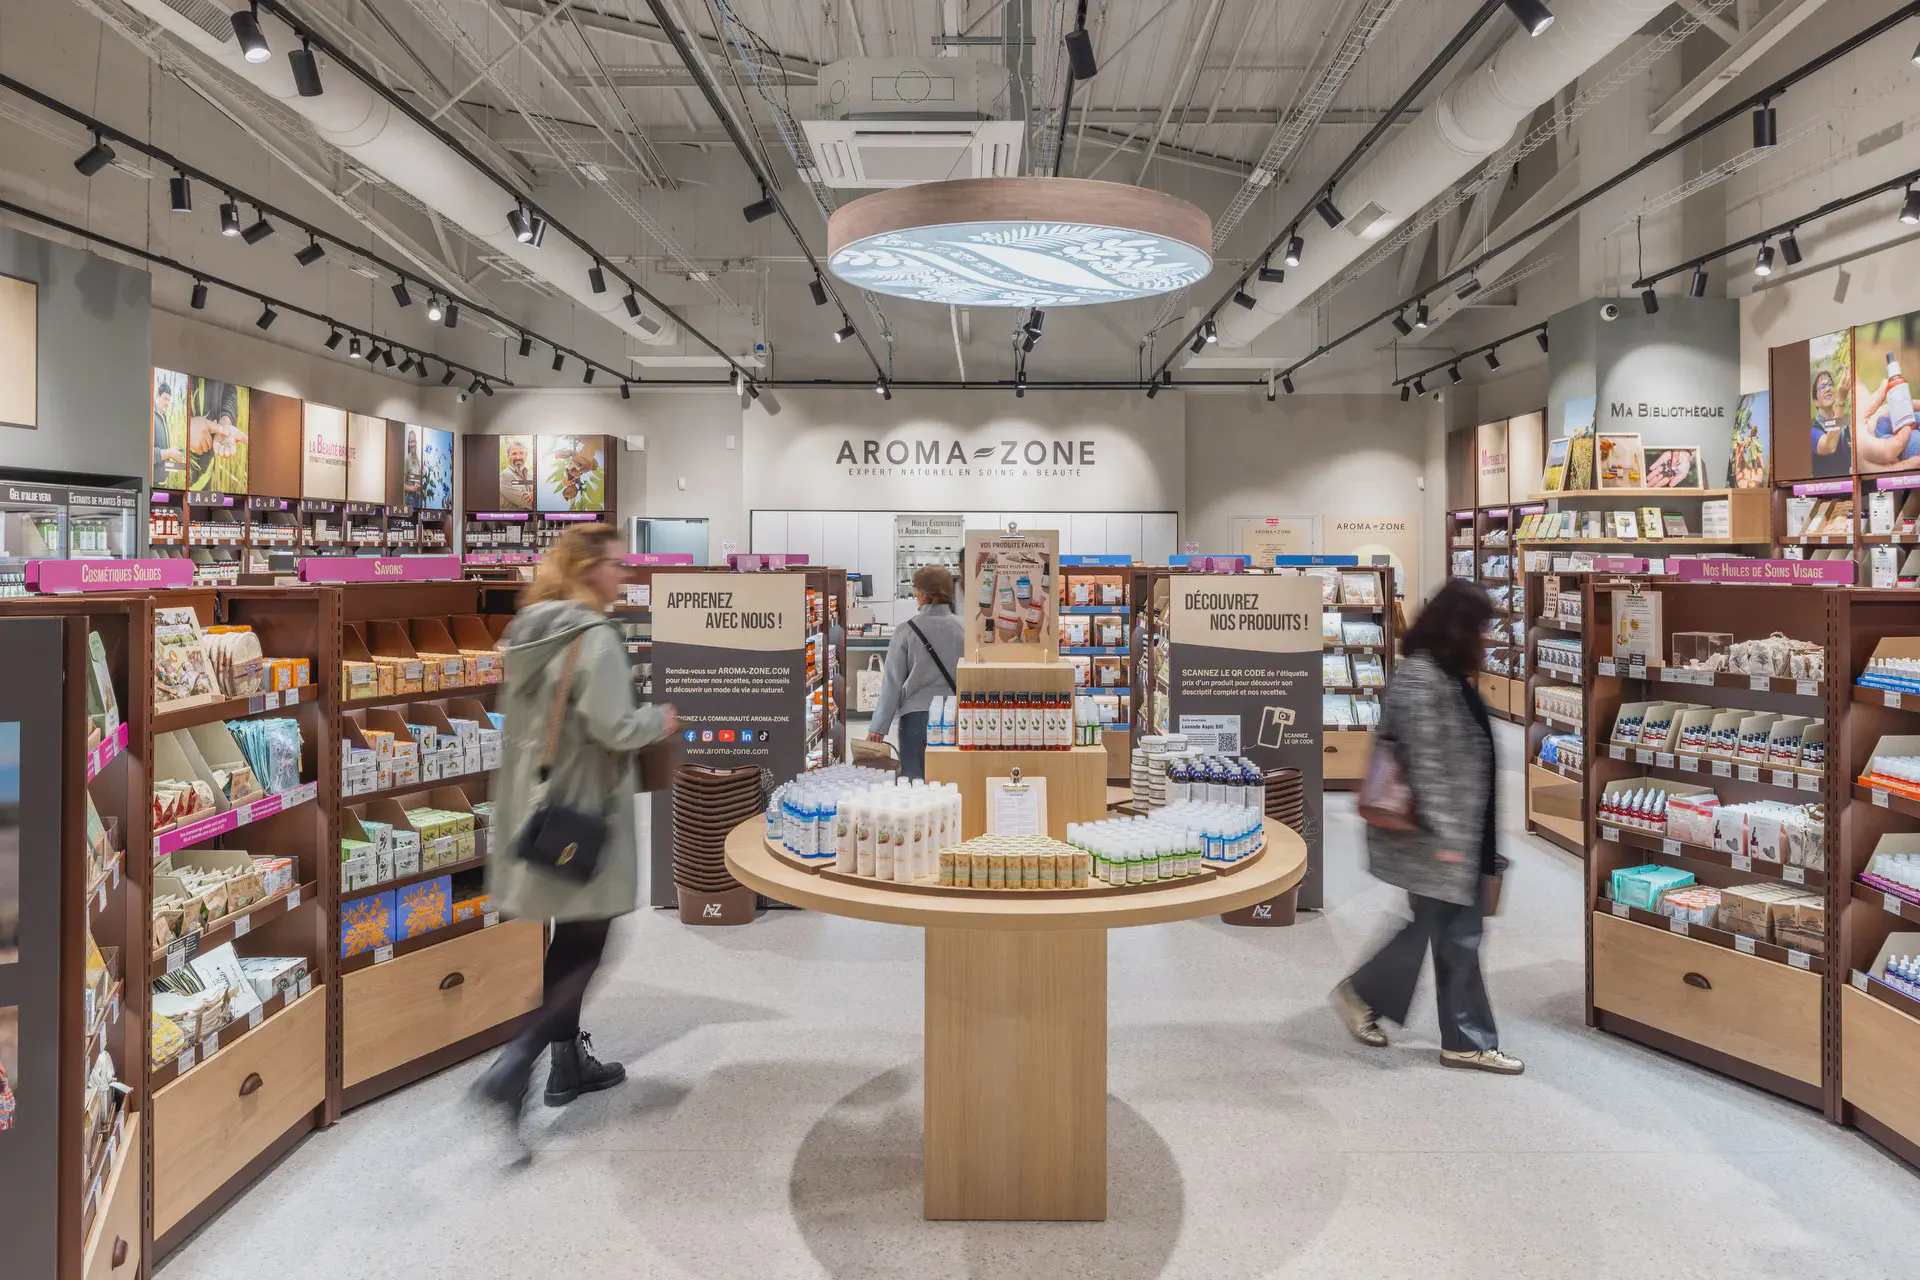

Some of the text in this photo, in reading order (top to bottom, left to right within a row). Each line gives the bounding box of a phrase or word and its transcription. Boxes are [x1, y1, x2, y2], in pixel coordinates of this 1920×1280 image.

[835, 440, 1096, 466] AROMA ZONE
[979, 468, 1014, 476] SOINS
[667, 592, 733, 609] APPRENEZ
[1185, 590, 1259, 610] DÉCOUVREZ
[705, 612, 782, 629] AVEC NOUS !
[1210, 614, 1308, 630] NOS PRODUITS !
